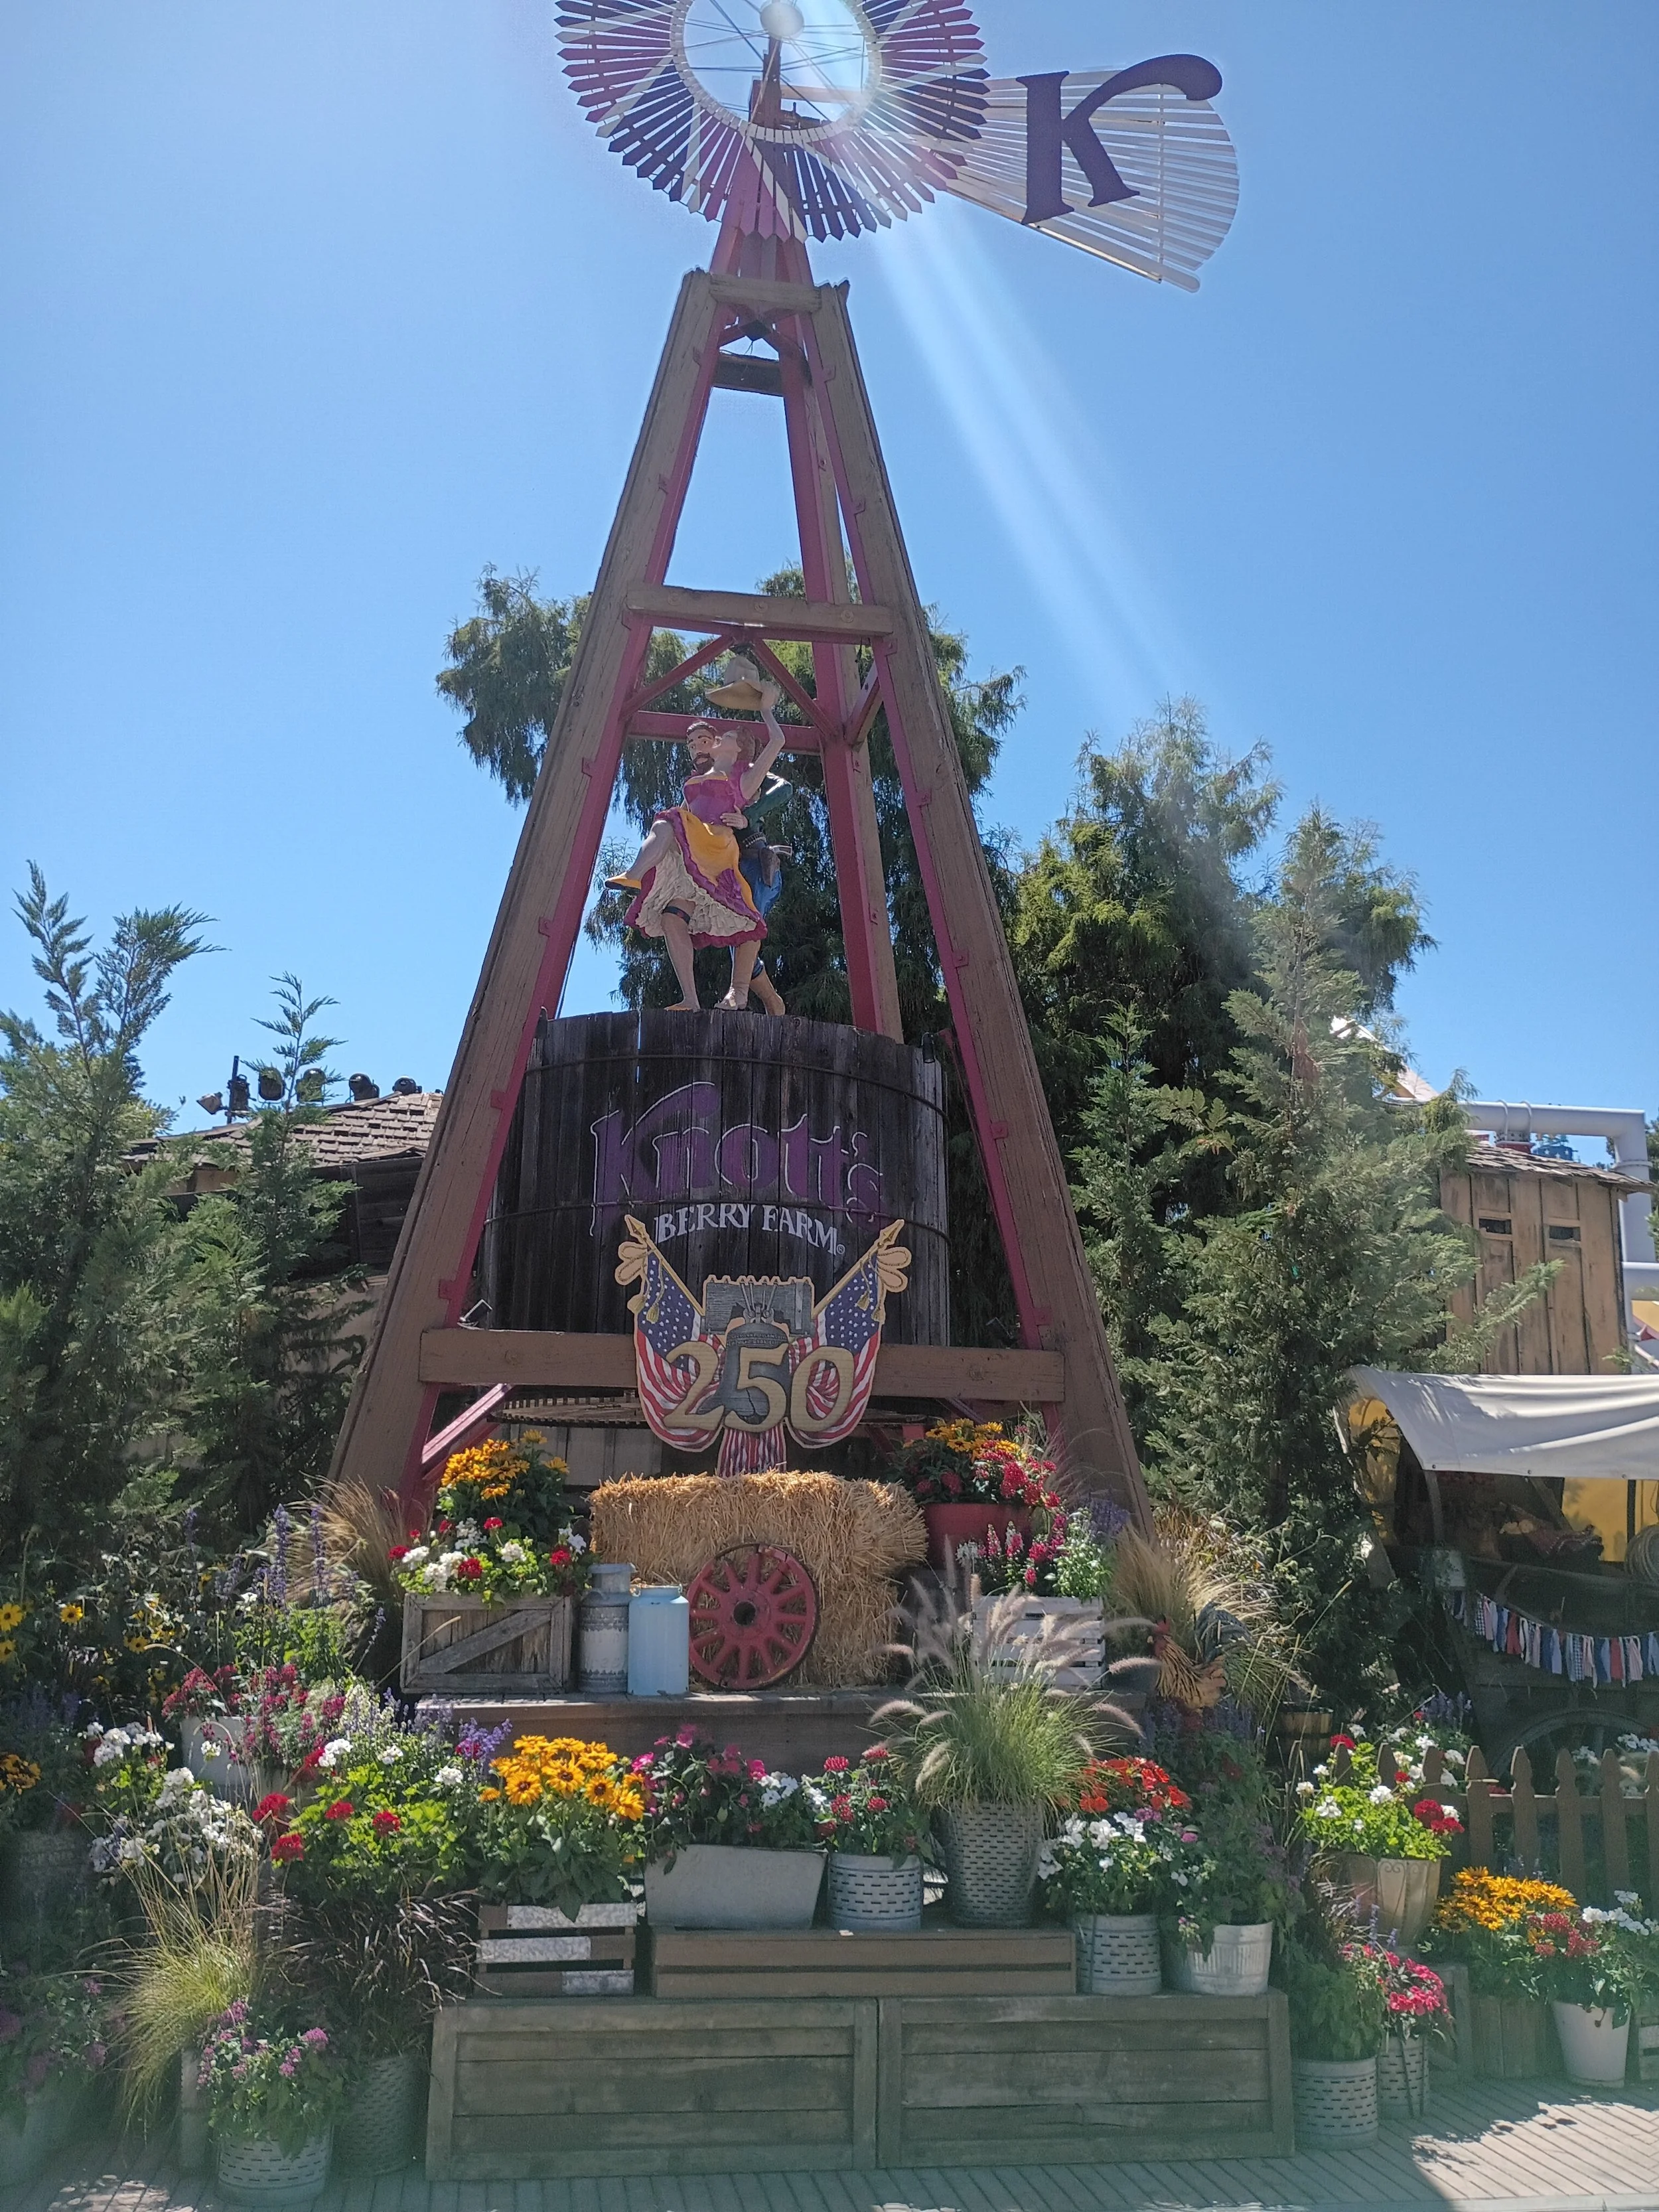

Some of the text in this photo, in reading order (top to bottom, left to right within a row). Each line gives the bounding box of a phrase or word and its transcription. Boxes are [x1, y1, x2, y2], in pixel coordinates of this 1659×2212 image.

[1016, 54, 1223, 224] K
[654, 1203, 755, 1244] BERRY
[665, 1342, 854, 1432] 250
